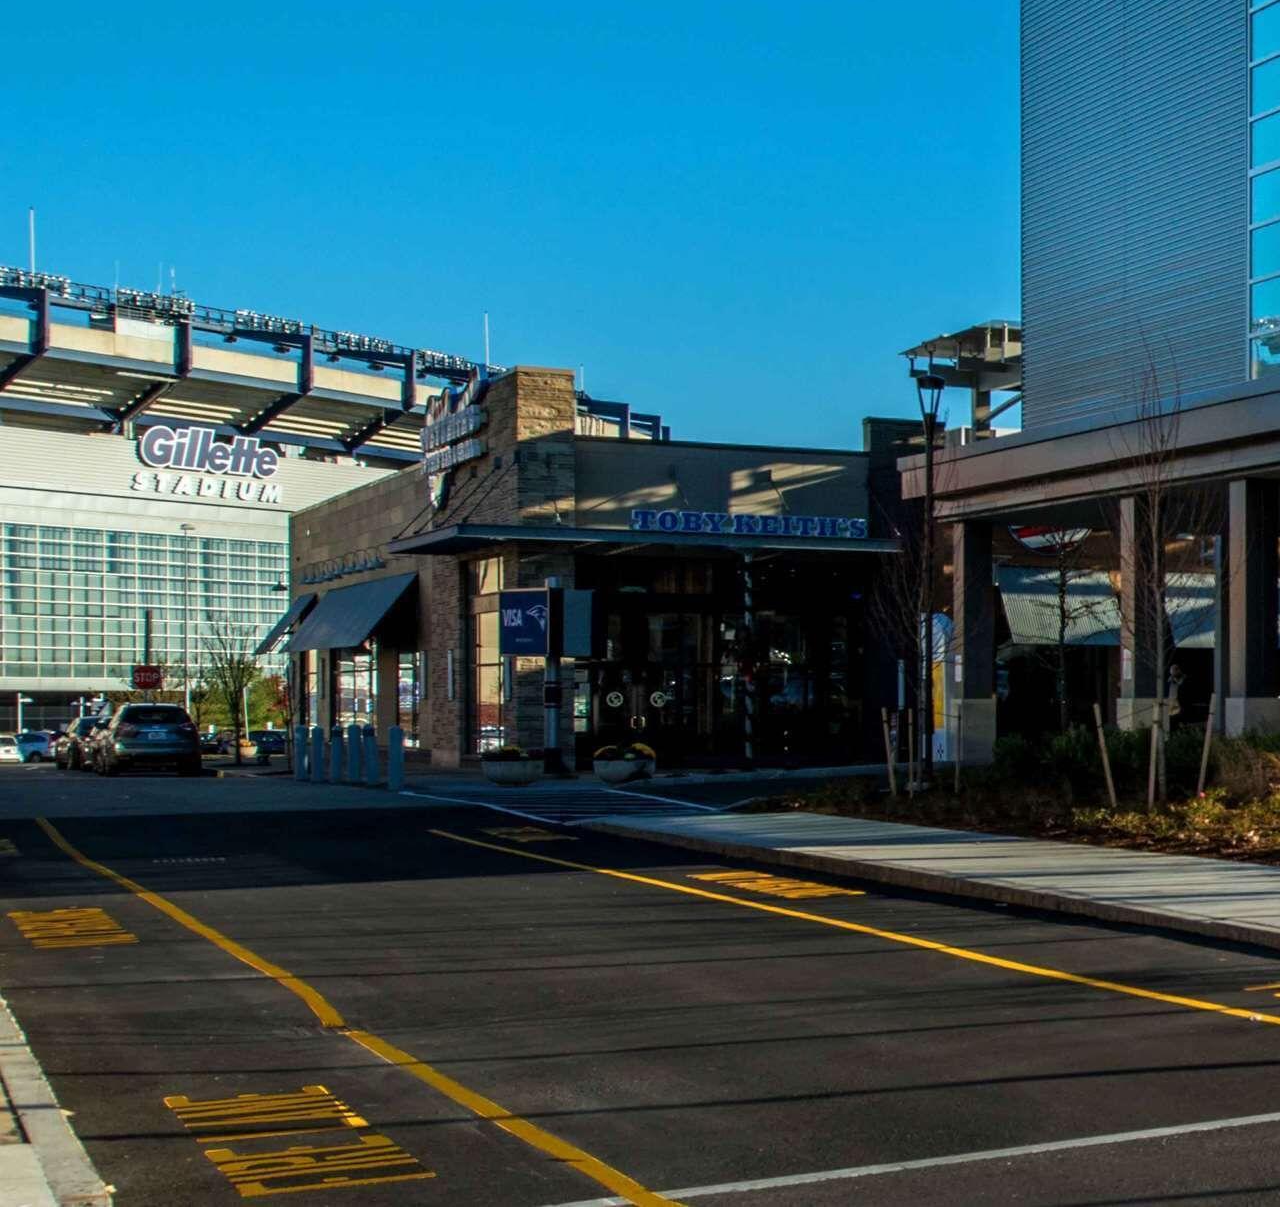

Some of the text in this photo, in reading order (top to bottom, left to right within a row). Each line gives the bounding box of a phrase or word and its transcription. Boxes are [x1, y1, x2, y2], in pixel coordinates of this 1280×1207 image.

[141, 425, 280, 478] Gillette
[131, 472, 283, 504] STADIUM
[632, 509, 867, 538] TOBY KEITH'S
[502, 608, 523, 627] VISA
[134, 672, 161, 684] STOP
